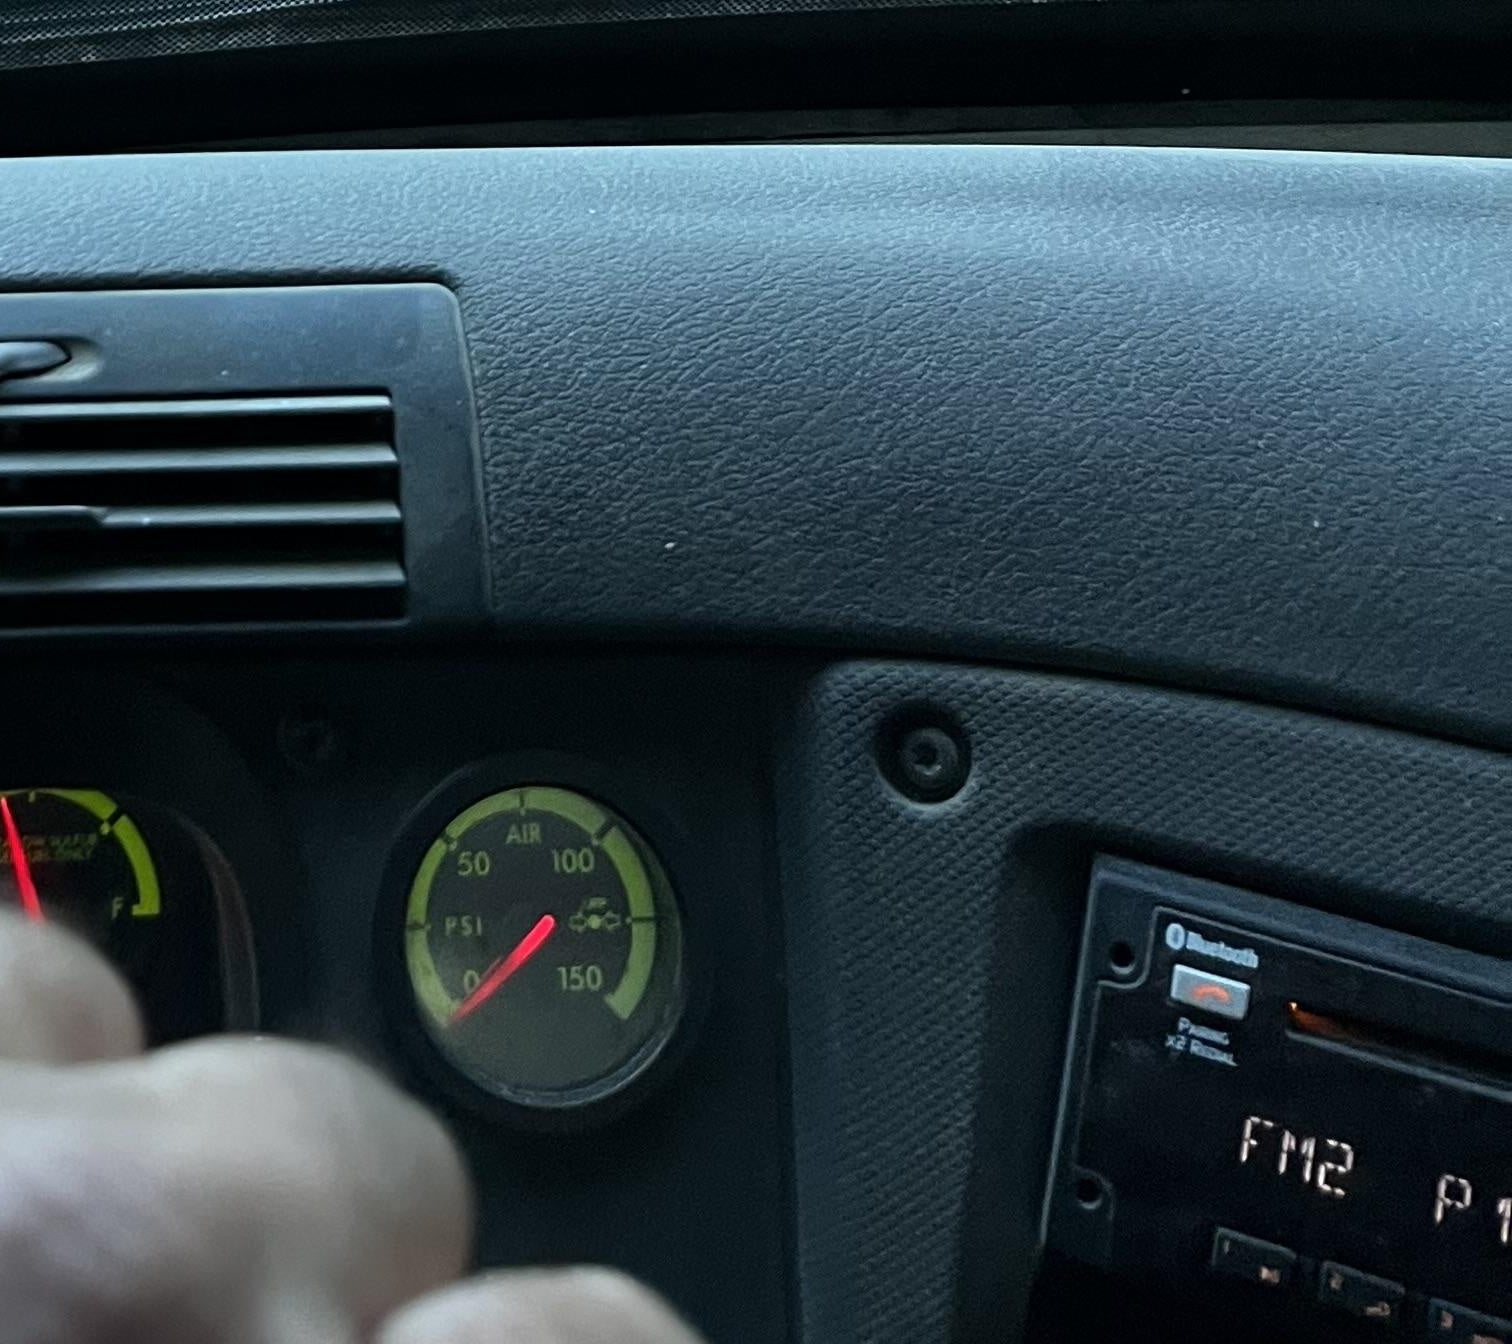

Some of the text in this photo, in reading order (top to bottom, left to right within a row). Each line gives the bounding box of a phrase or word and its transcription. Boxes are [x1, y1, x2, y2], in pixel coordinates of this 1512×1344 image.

[505, 823, 541, 845] AIR
[457, 851, 490, 876] 50
[552, 848, 595, 873] 100
[111, 896, 124, 920] F
[444, 916, 483, 936] PSI
[463, 970, 481, 993] 0
[558, 966, 602, 992] 150
[1239, 1115, 1355, 1197] FM2
